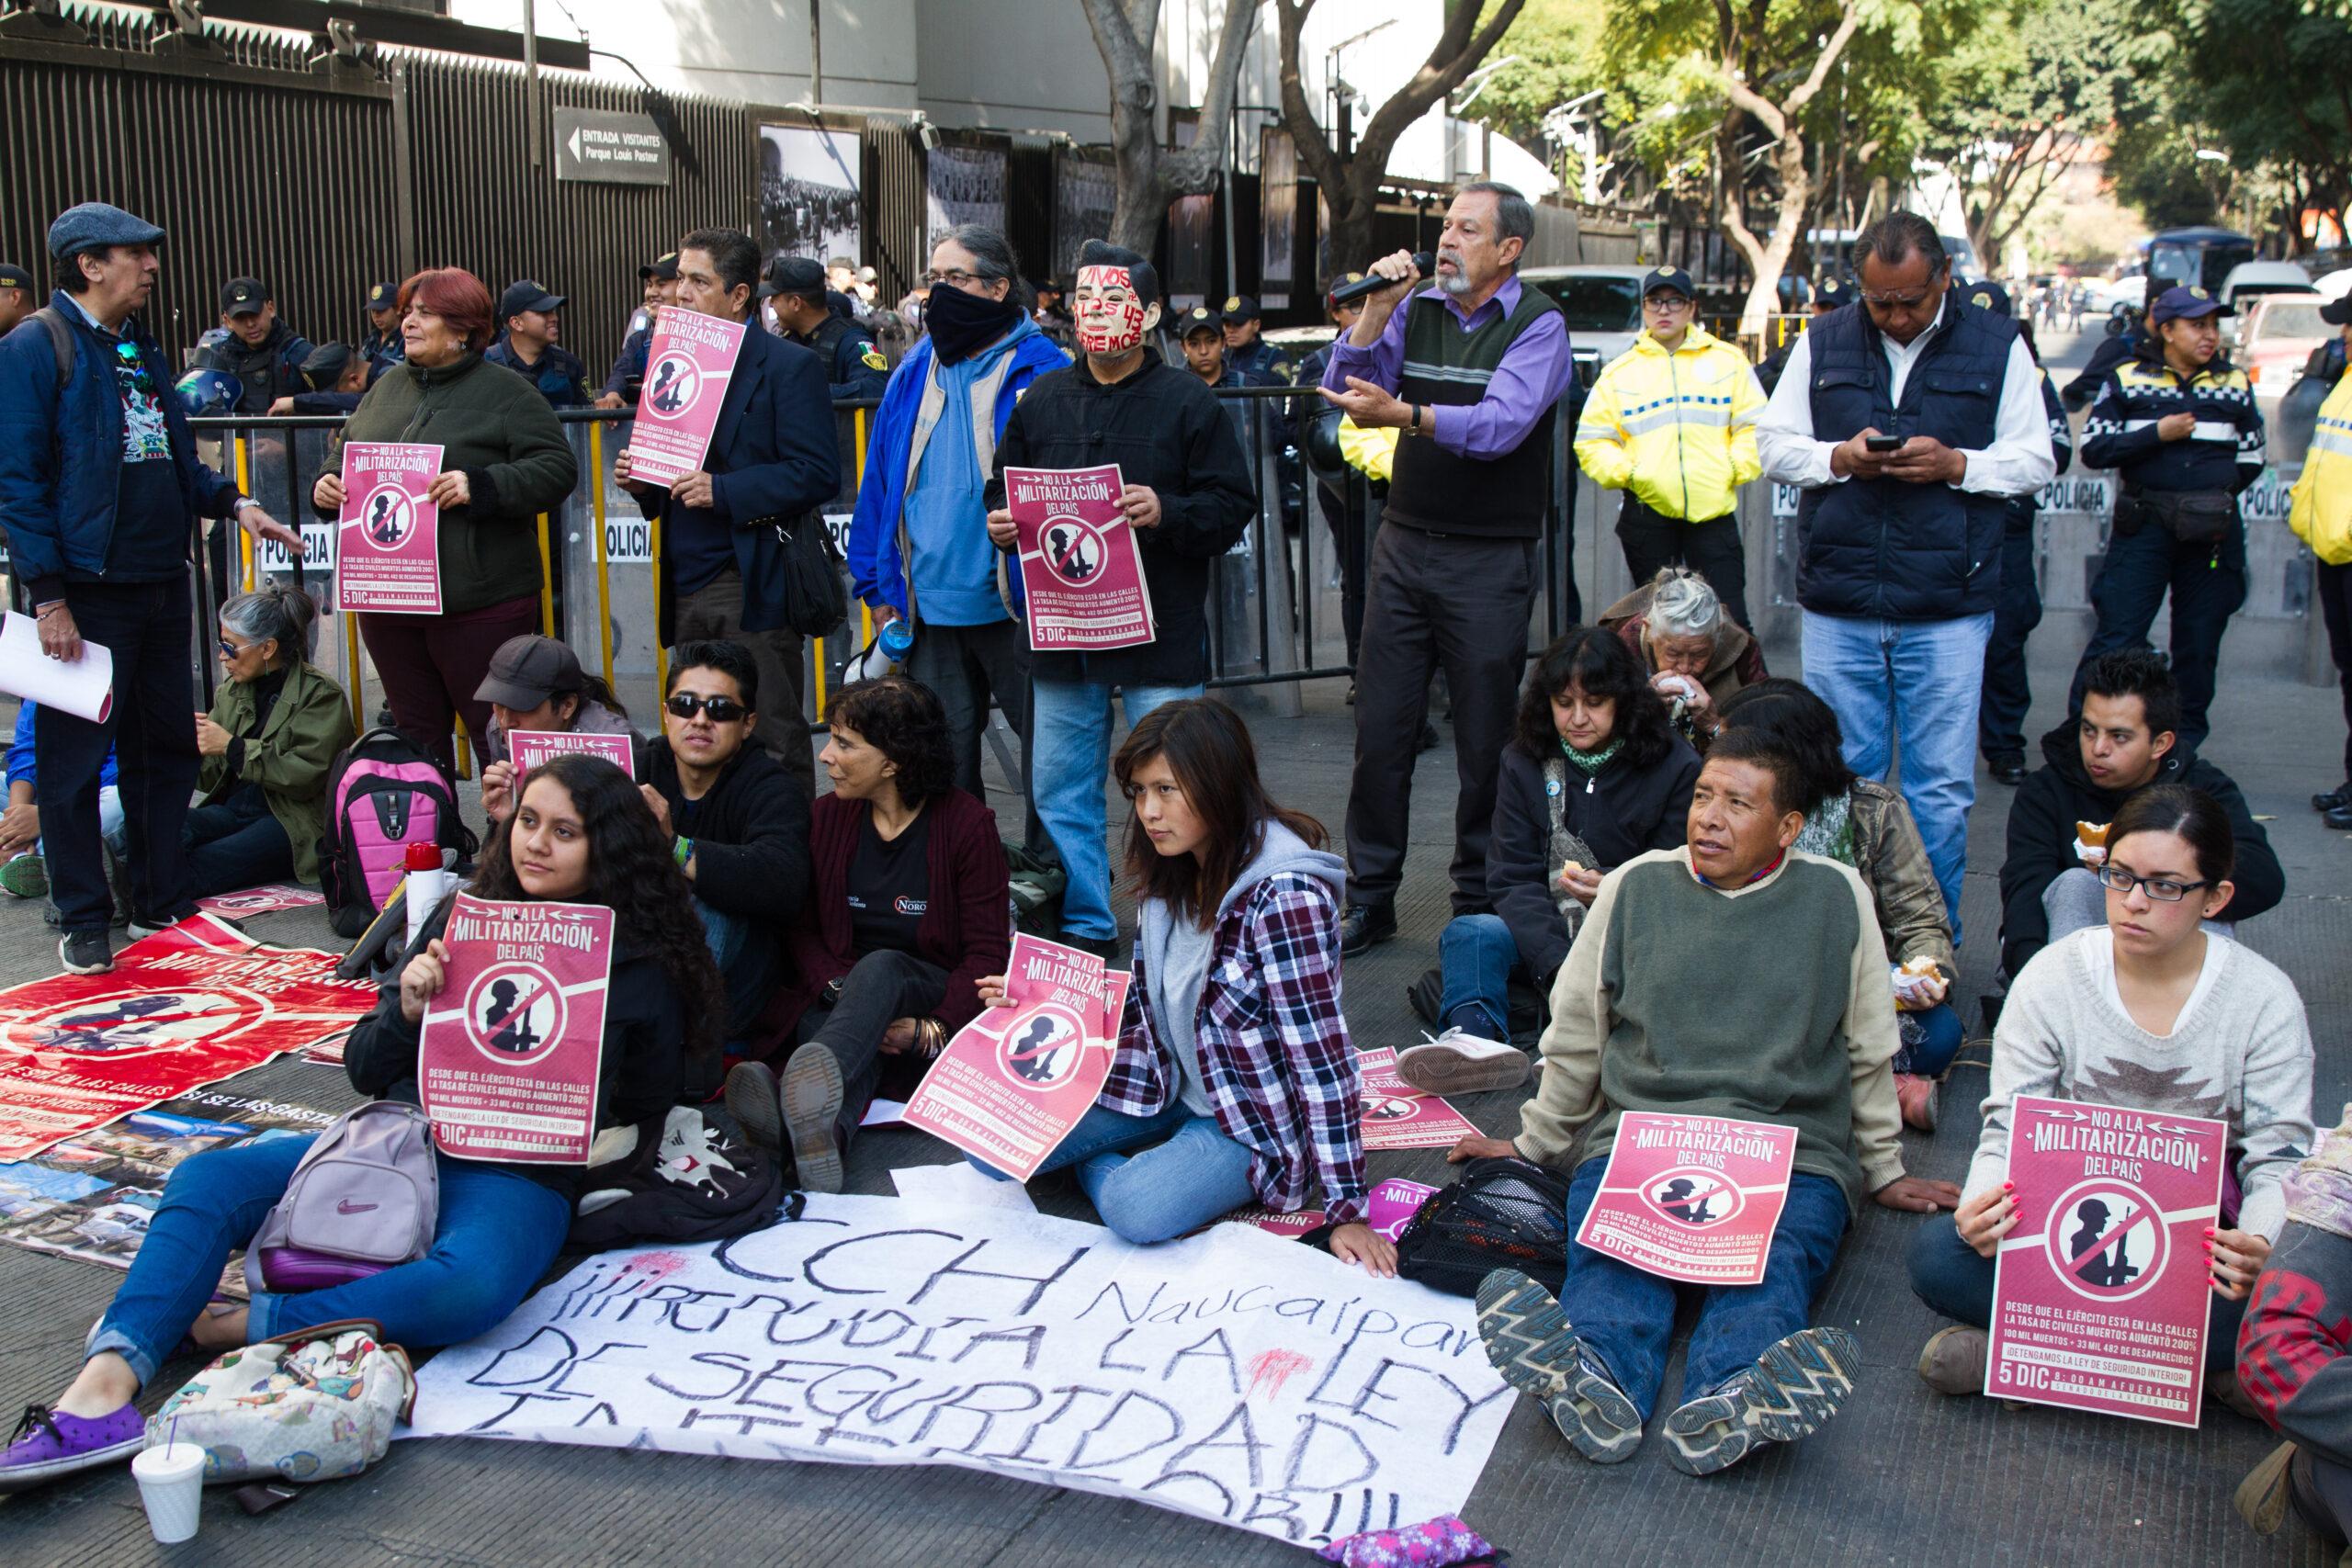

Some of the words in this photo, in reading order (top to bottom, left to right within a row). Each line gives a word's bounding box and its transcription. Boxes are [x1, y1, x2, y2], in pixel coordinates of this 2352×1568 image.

[582, 130, 619, 143] ENTRADA
[623, 133, 660, 147] VISITANTES
[586, 147, 611, 162] Parque
[614, 149, 632, 161] Louis
[635, 150, 658, 163] Pasteur
[677, 311, 685, 322] NO
[687, 315, 693, 323] A
[694, 316, 703, 327] LA
[1124, 305, 1144, 331] 43
[668, 338, 680, 350] DEL
[681, 340, 697, 355] PAÍS
[379, 446, 390, 456] NO
[390, 446, 395, 456] A
[396, 446, 404, 457] LA
[356, 456, 430, 475] MILITARIZACIÓN
[377, 471, 389, 483] DEL
[389, 471, 402, 483] PAÍS
[1043, 475, 1054, 485] NO
[1056, 475, 1061, 484] A
[1063, 475, 1072, 485] LA
[1017, 482, 1110, 503] MILITARIZACIÓN
[2244, 487, 2290, 517] POLIC
[1046, 503, 1060, 515] DEL
[1060, 502, 1080, 515] PAÍS
[266, 533, 328, 563] POLCIA
[606, 525, 651, 557] OLICI
[344, 592, 350, 604] 5
[352, 592, 368, 604] DIC
[1037, 628, 1046, 642] 5
[1046, 627, 1067, 641] DIC
[554, 738, 565, 749] NO
[567, 738, 572, 749] A
[574, 739, 584, 750] LA
[502, 906, 518, 920] NO
[520, 908, 528, 920] A
[532, 908, 546, 920] LA
[454, 915, 593, 952] MILITARIZACIÓN
[497, 944, 518, 961] DEL
[519, 943, 544, 963] PAÍS
[1067, 953, 1081, 968] NO
[1083, 960, 1090, 971] A
[1089, 962, 1099, 975] LA
[1049, 987, 1070, 1005] DEL
[1070, 991, 1089, 1013] PAÍS
[75, 1077, 113, 1089] LAS
[108, 1082, 173, 1096] CALLES
[202, 1094, 236, 1105] SE
[228, 1099, 271, 1112] LAS
[912, 1095, 924, 1114] 5
[922, 1100, 948, 1122] DIC
[1686, 1120, 1702, 1133] NO
[1704, 1122, 1712, 1133] A
[1714, 1122, 1728, 1134] LA
[2091, 1111, 2110, 1128] NO
[2114, 1113, 2122, 1130] A
[2127, 1114, 2143, 1133] LA
[441, 1124, 466, 1146] DIC
[1636, 1129, 1774, 1162] MILITARIZACIÓN
[2034, 1122, 2199, 1174] MILITARIZACIÓN
[1677, 1151, 1700, 1165] DEL
[1701, 1152, 1726, 1169] PAÍS
[2085, 1156, 2109, 1177] DEL
[2111, 1157, 2143, 1183] PAÍS
[1589, 1230, 1601, 1243] 5
[1604, 1236, 1634, 1256] DIC
[712, 1219, 1091, 1316] CCH
[2006, 1301, 2032, 1314] DESDE
[2035, 1305, 2052, 1317] QUE
[2054, 1308, 2064, 1319] EL
[2066, 1310, 2106, 1325] EJÉRCITO
[2109, 1315, 2130, 1329] ESTÁ
[2132, 1320, 2143, 1331] EN
[2146, 1322, 2163, 1334] LAS
[2165, 1325, 2198, 1338] CALLES
[2005, 1314, 2016, 1325] LA
[2018, 1316, 2038, 1328] TASA
[2040, 1319, 2051, 1330] DE
[2052, 1321, 2085, 1335] CIVILES
[2086, 1326, 2127, 1341] MUERTOS
[2129, 1332, 2170, 1348] AUMENTÓ
[2172, 1338, 2197, 1351] 200%
[2004, 1328, 2017, 1339] 100
[2018, 1331, 2031, 1341] MIL
[2033, 1333, 2067, 1347] MUERTOS
[2076, 1339, 2086, 1349] 33
[2088, 1341, 2101, 1351] MIL
[2104, 1343, 2118, 1354] 482
[2120, 1346, 2131, 1356] DE
[2132, 1348, 2193, 1365] DESAPARECIDOS
[1998, 1361, 2012, 1384] 5
[2017, 1363, 2049, 1390] DIC
[2007, 1348, 2062, 1364] ¡DETENGAMOS
[2063, 1355, 2074, 1366] LA
[2075, 1357, 2088, 1368] LEY
[2090, 1359, 2101, 1370] DE
[2103, 1361, 2146, 1376] SEGURIDAD
[2148, 1368, 2188, 1382] INTERIOR!
[1100, 1327, 1241, 1393] LA
[1305, 1343, 1511, 1456] LEY
[467, 1326, 648, 1398] DE
[645, 1352, 1378, 1491] SEGURIDAD
